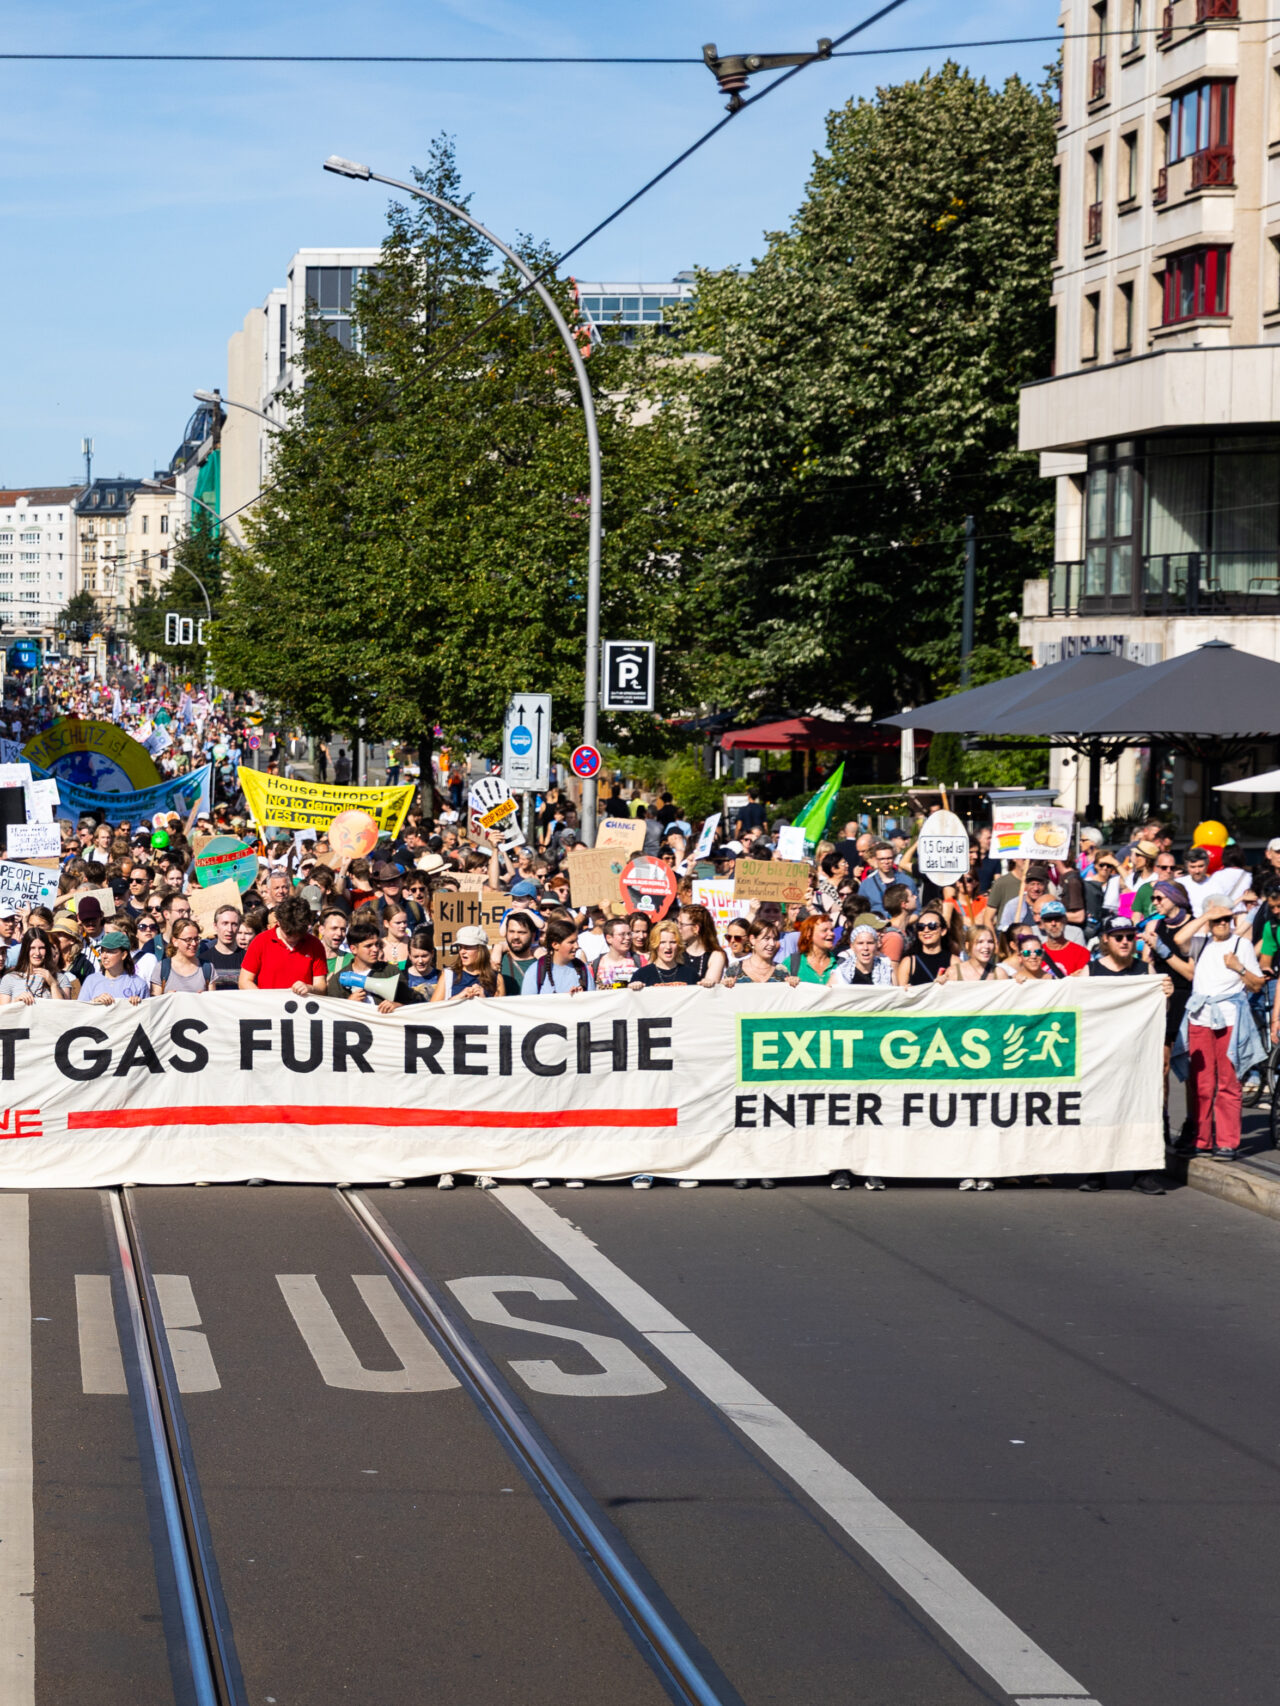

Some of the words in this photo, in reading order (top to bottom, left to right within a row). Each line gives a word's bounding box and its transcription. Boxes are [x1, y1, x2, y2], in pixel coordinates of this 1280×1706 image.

[618, 661, 639, 689] P
[267, 778, 318, 797] House
[268, 794, 288, 807] NO
[290, 797, 303, 809] to
[267, 809, 292, 821] YES
[293, 811, 307, 823] to
[605, 820, 636, 831] CHANGE
[936, 839, 953, 854] Grad
[926, 856, 939, 869] das
[939, 855, 959, 869] Limit
[0, 865, 45, 885] PEOPLE
[0, 879, 42, 894] PLANET
[439, 900, 464, 924] Kill
[467, 901, 506, 925] the
[54, 1018, 209, 1082] GAS
[239, 1000, 375, 1074] FÜR
[404, 1016, 673, 1077] REICHE
[752, 1029, 864, 1070] EXIT
[879, 1027, 992, 1070] GAS
[734, 1092, 883, 1128] ENTER
[902, 1090, 1082, 1128] FUTURE
[74, 1274, 668, 1397] BUS
